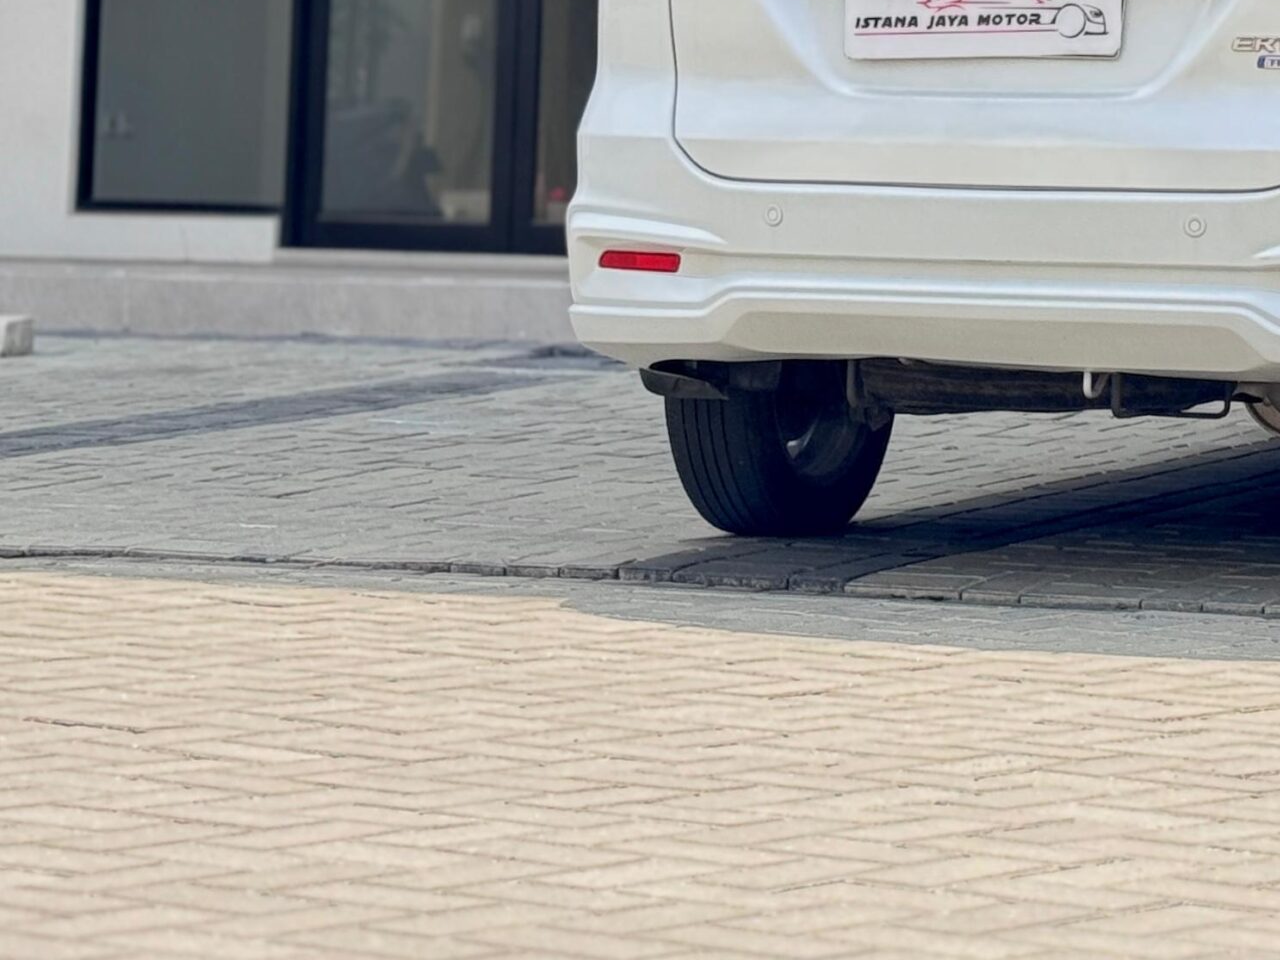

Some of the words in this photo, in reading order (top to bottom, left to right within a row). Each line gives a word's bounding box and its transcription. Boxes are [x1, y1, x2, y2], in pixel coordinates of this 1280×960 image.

[855, 16, 918, 29] ISTANA
[927, 15, 969, 29] JAYA
[977, 13, 1041, 26] MOTOR
